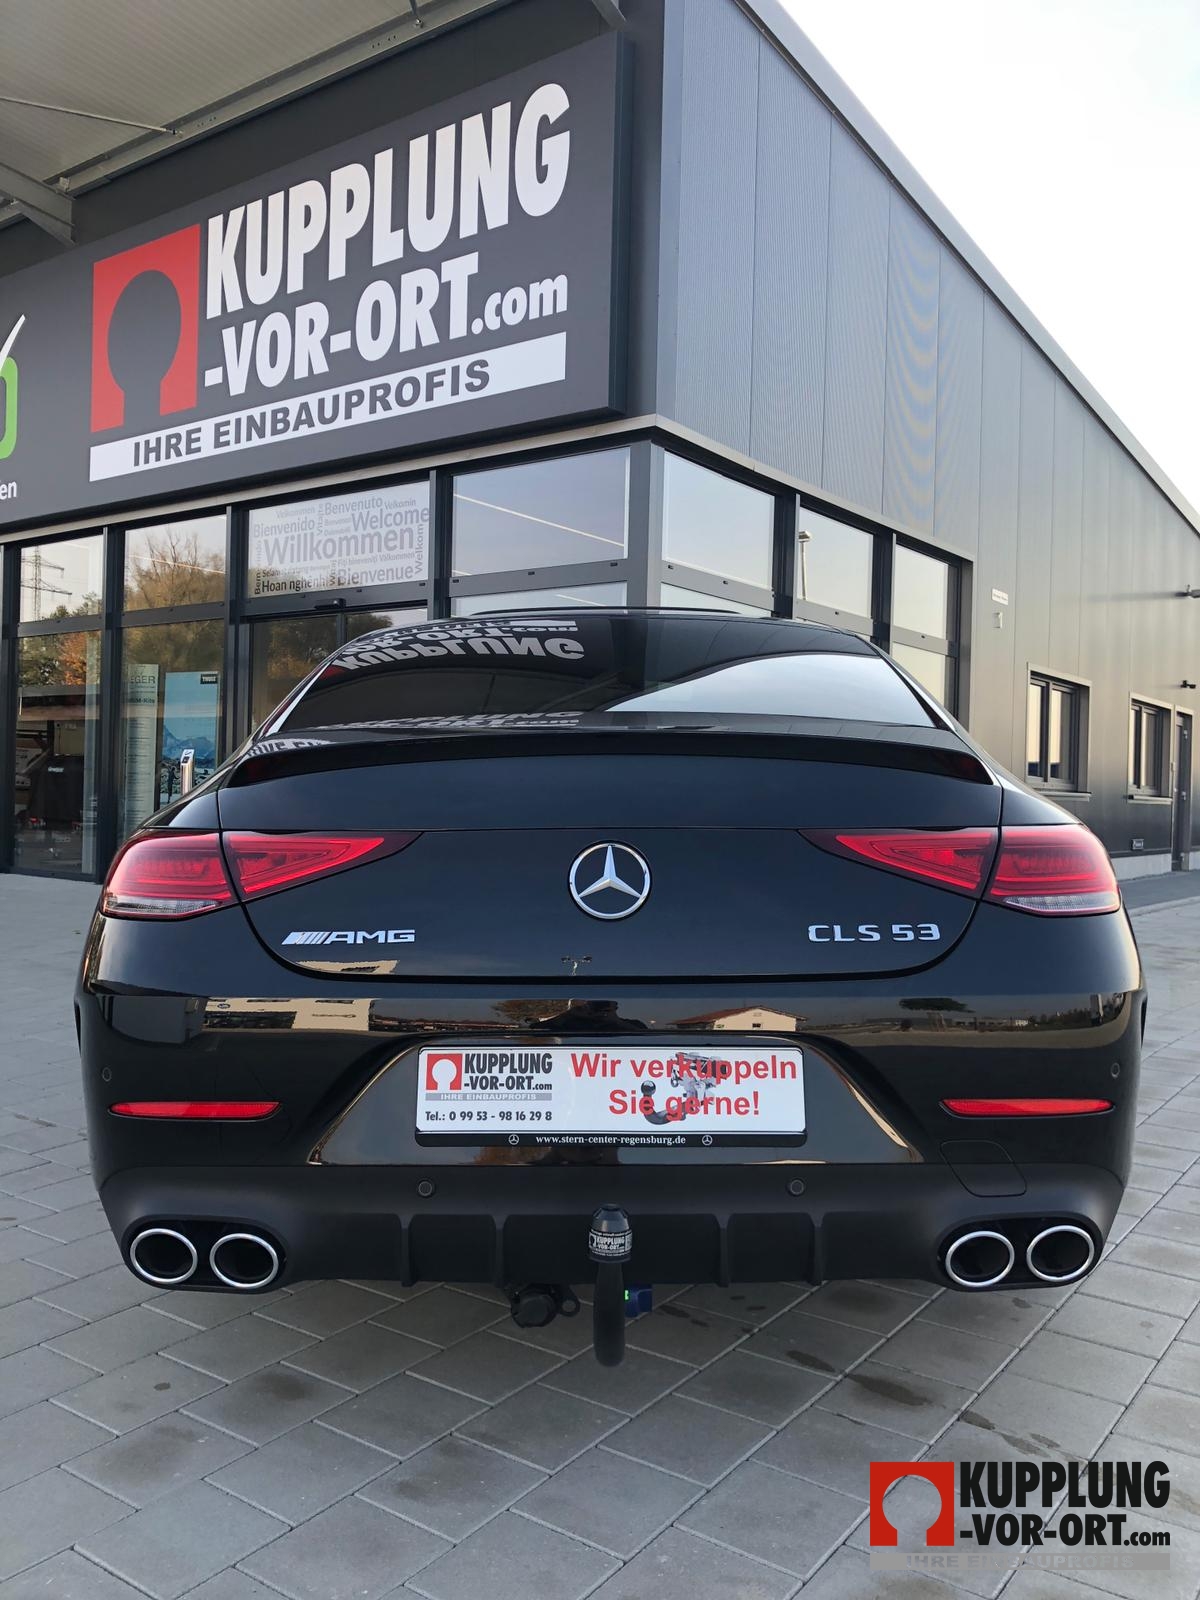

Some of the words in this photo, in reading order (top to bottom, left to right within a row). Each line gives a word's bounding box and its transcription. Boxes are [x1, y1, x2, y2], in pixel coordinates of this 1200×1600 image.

[206, 83, 570, 320] KUPPLUNG
[204, 251, 568, 397] -VOR-ORT.com
[132, 422, 203, 467] IHRE
[213, 358, 491, 450] EINBAUPROFIS
[325, 497, 383, 516] Benvenuto
[253, 516, 316, 538] Bienvenido
[351, 507, 429, 532] Welcome
[263, 527, 414, 566] Willkommen
[413, 523, 425, 575] Welkom
[262, 578, 288, 593] Hoan
[337, 565, 414, 587] Bienvenue
[327, 929, 416, 945] AMG
[807, 923, 883, 943] CLS
[892, 923, 942, 943] 53
[464, 1053, 552, 1074] KUPPLUNG
[571, 1053, 622, 1078] Wir
[630, 1054, 797, 1084] verkuppeln
[464, 1075, 552, 1090] -VOR-ORT.com
[426, 1111, 445, 1121] Tel.:
[449, 1111, 456, 1121] 0
[460, 1111, 473, 1121] 99
[477, 1111, 488, 1121] 53
[499, 1111, 512, 1121] 98
[516, 1111, 526, 1121] 16
[530, 1111, 542, 1121] 29
[545, 1111, 552, 1121] 8
[609, 1089, 655, 1115] Sie
[665, 1091, 760, 1121] gerne!
[536, 1135, 686, 1146] www.stern-center-regensburg.de
